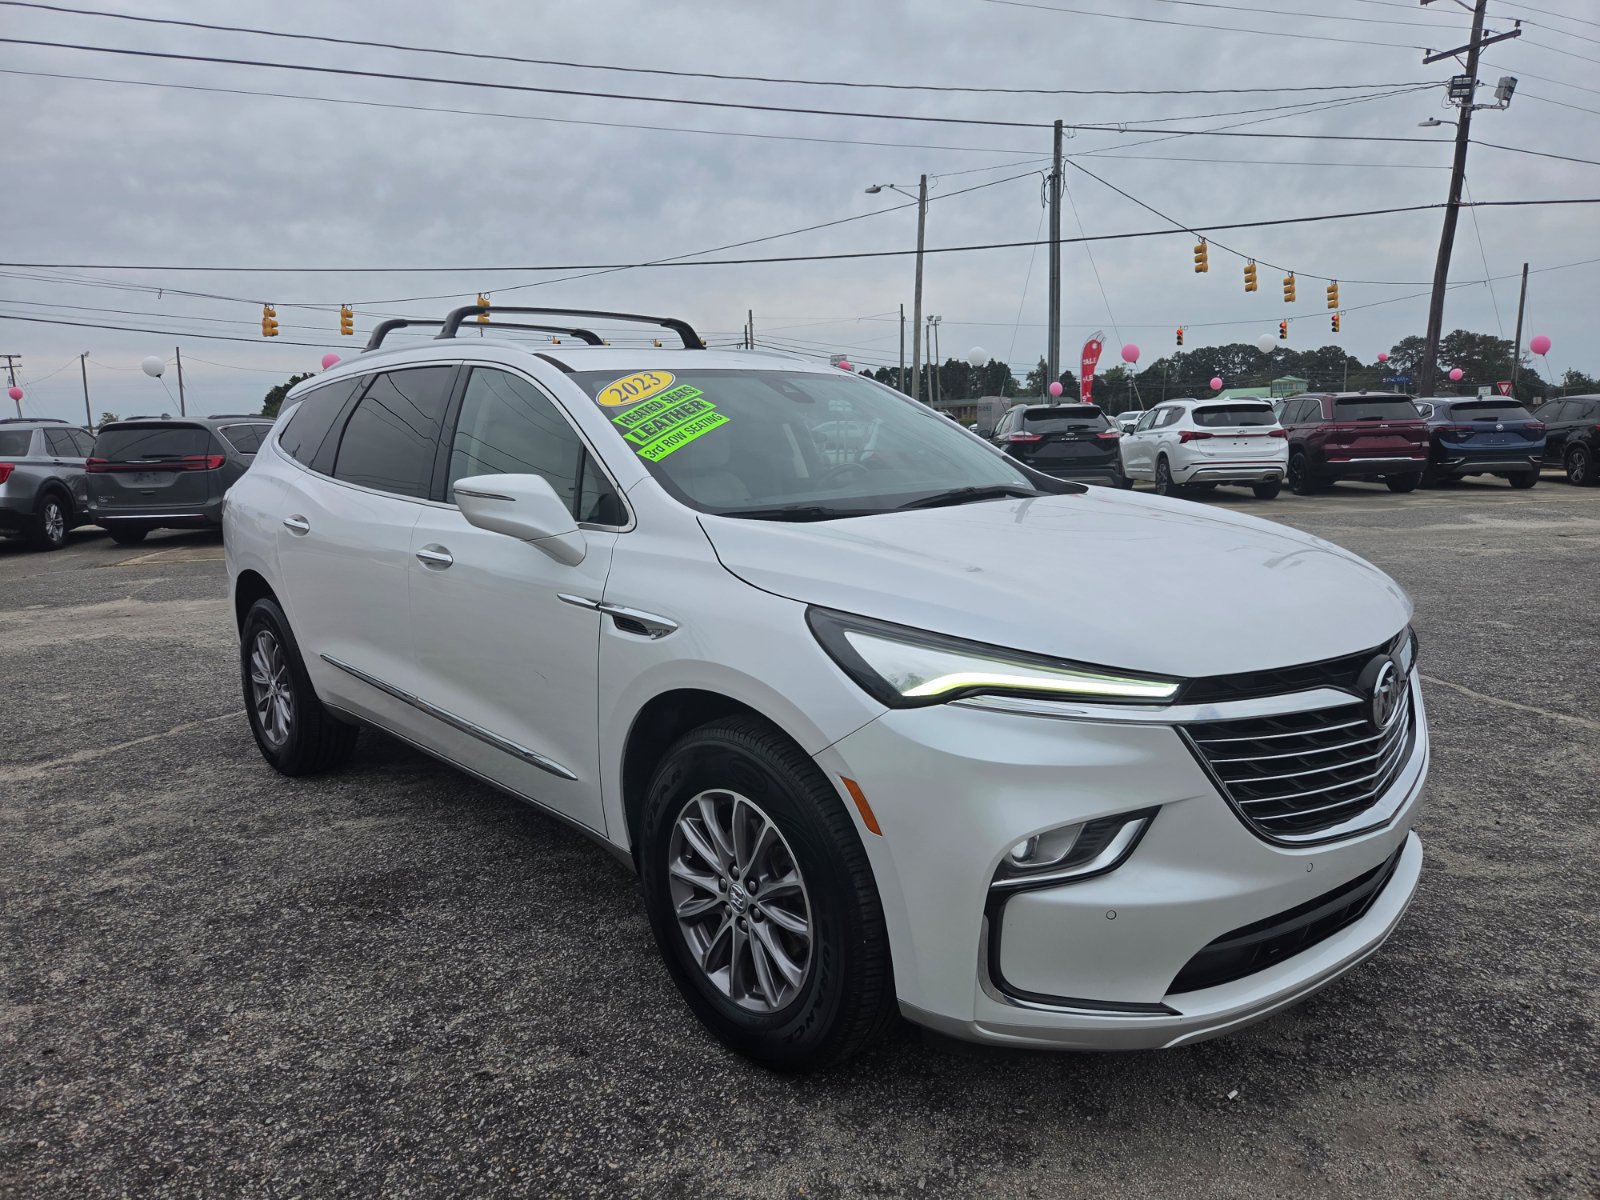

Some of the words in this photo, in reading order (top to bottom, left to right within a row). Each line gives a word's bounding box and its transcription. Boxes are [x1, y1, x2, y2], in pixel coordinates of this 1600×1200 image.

[609, 373, 661, 402] 2023
[617, 401, 665, 426] HEATED
[660, 386, 698, 405] SEATS
[630, 400, 707, 442] LEATHER
[644, 445, 666, 459] 3rd
[661, 430, 688, 448] ROW
[685, 413, 723, 435] SEATING
